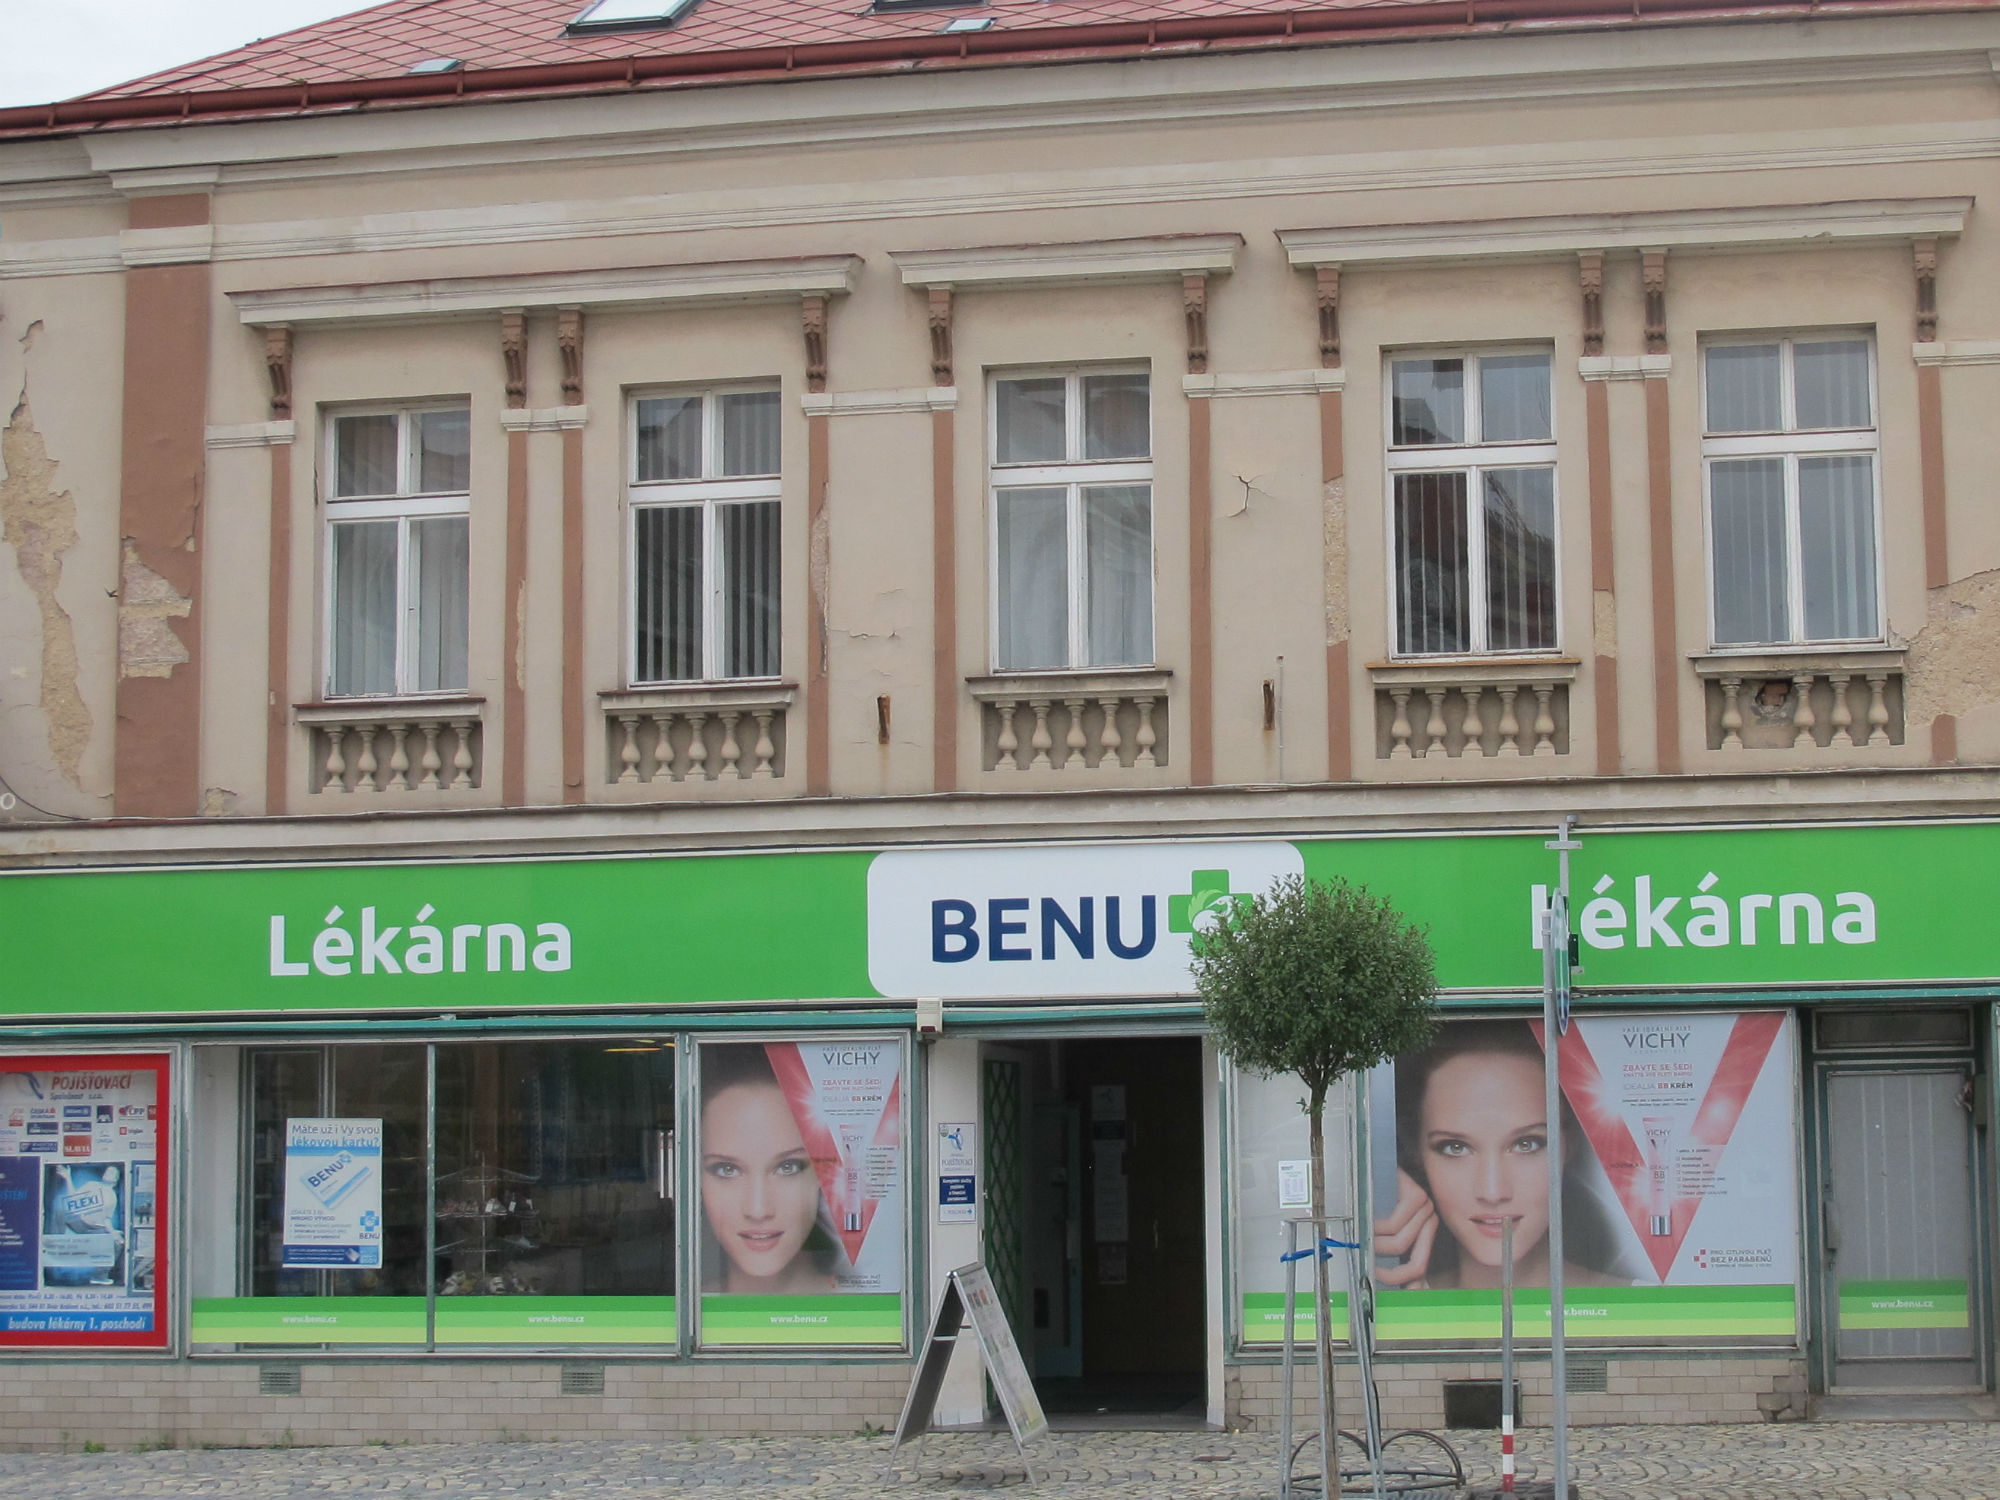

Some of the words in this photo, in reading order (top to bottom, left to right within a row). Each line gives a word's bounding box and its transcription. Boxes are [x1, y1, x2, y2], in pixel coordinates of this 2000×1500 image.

[932, 895, 1156, 962] BENU
[270, 903, 571, 976] Lékárna
[1623, 1033, 1690, 1048] VICHY
[823, 1052, 880, 1065] VICHY
[51, 1072, 131, 1090] POJIŠŤOVACÍ
[292, 1125, 318, 1134] Máte
[321, 1124, 332, 1134] už
[341, 1125, 354, 1136] Vy
[356, 1126, 380, 1134] svou
[342, 1136, 379, 1147] kartu?
[308, 1160, 344, 1187] BENU
[8, 1317, 46, 1329] budova
[48, 1316, 86, 1331] lékárny
[90, 1317, 98, 1329] 1.
[100, 1316, 147, 1331] poschodí
[282, 1315, 337, 1323] www.benu.cz
[528, 1315, 585, 1323] www.benu.cz
[770, 1314, 828, 1323] www.benu.cz
